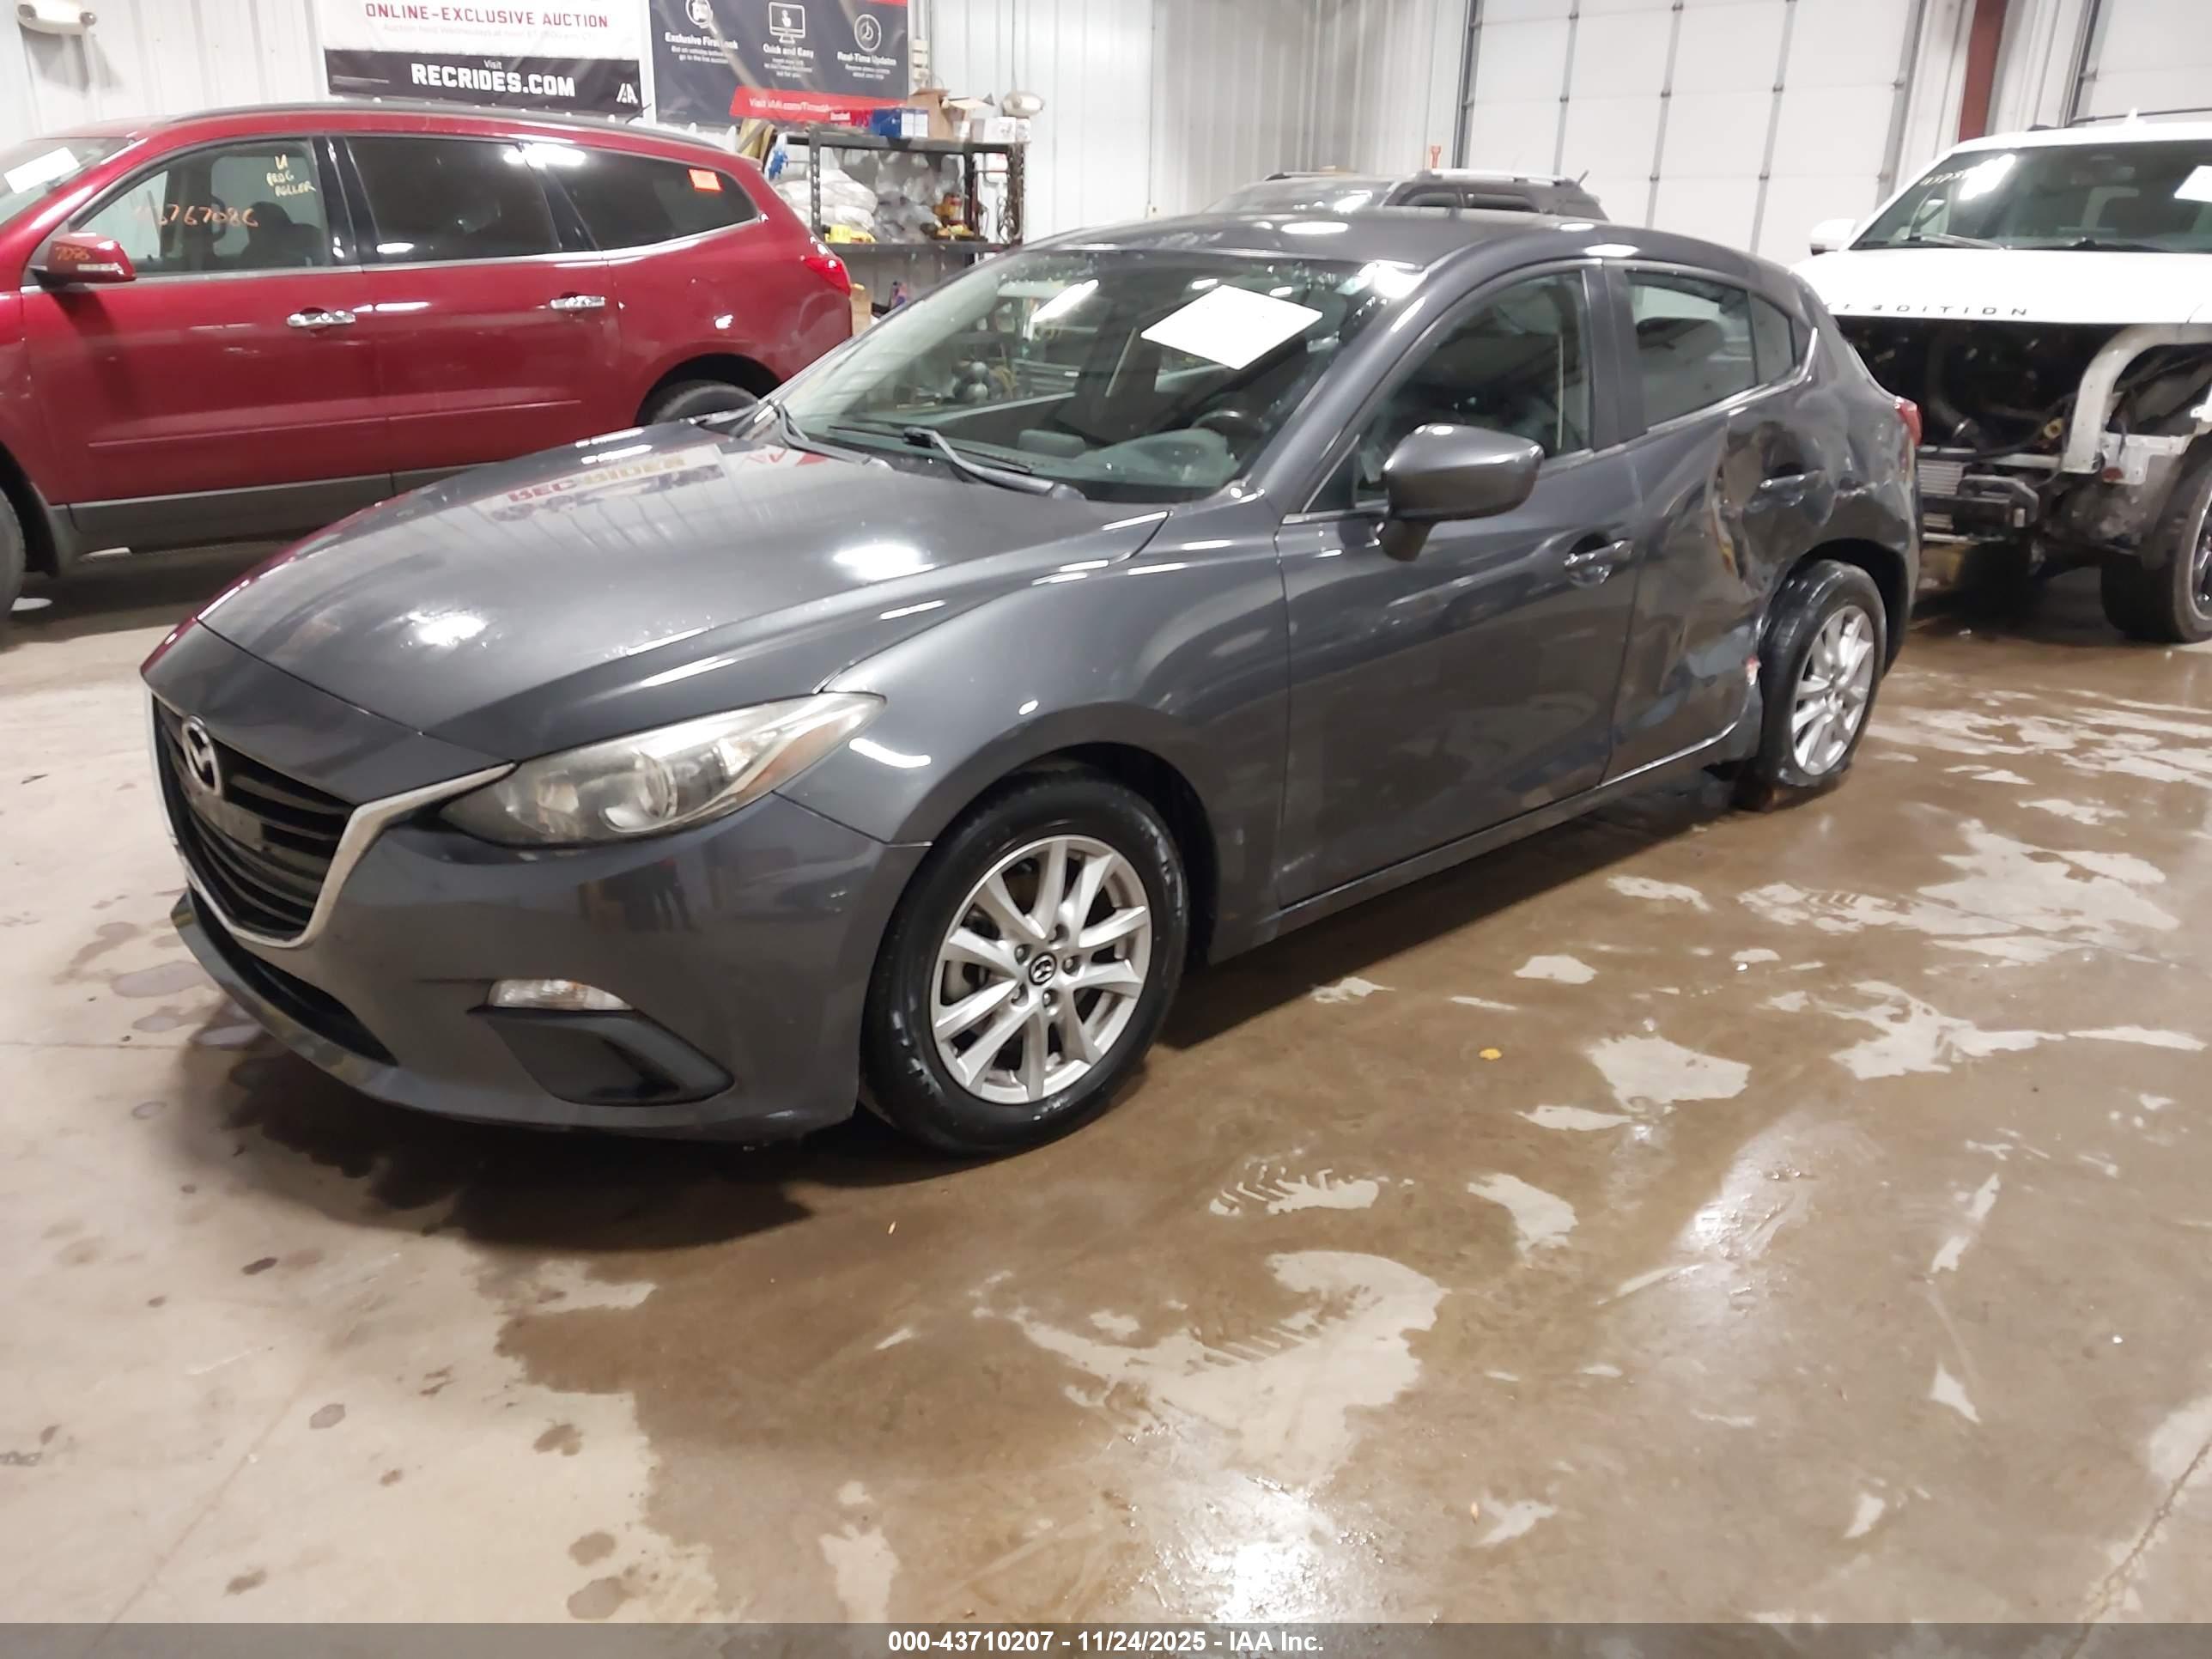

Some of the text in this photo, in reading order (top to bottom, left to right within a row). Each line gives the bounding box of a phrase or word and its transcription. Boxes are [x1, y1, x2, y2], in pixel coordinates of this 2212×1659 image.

[366, 3, 609, 28] ONLINE-EXCLUSIVE AUCTION
[782, 47, 796, 56] and
[797, 47, 815, 59] Easy
[484, 59, 502, 70] Visit
[410, 63, 575, 97] RECRIDES.COM
[749, 97, 766, 108] Visit
